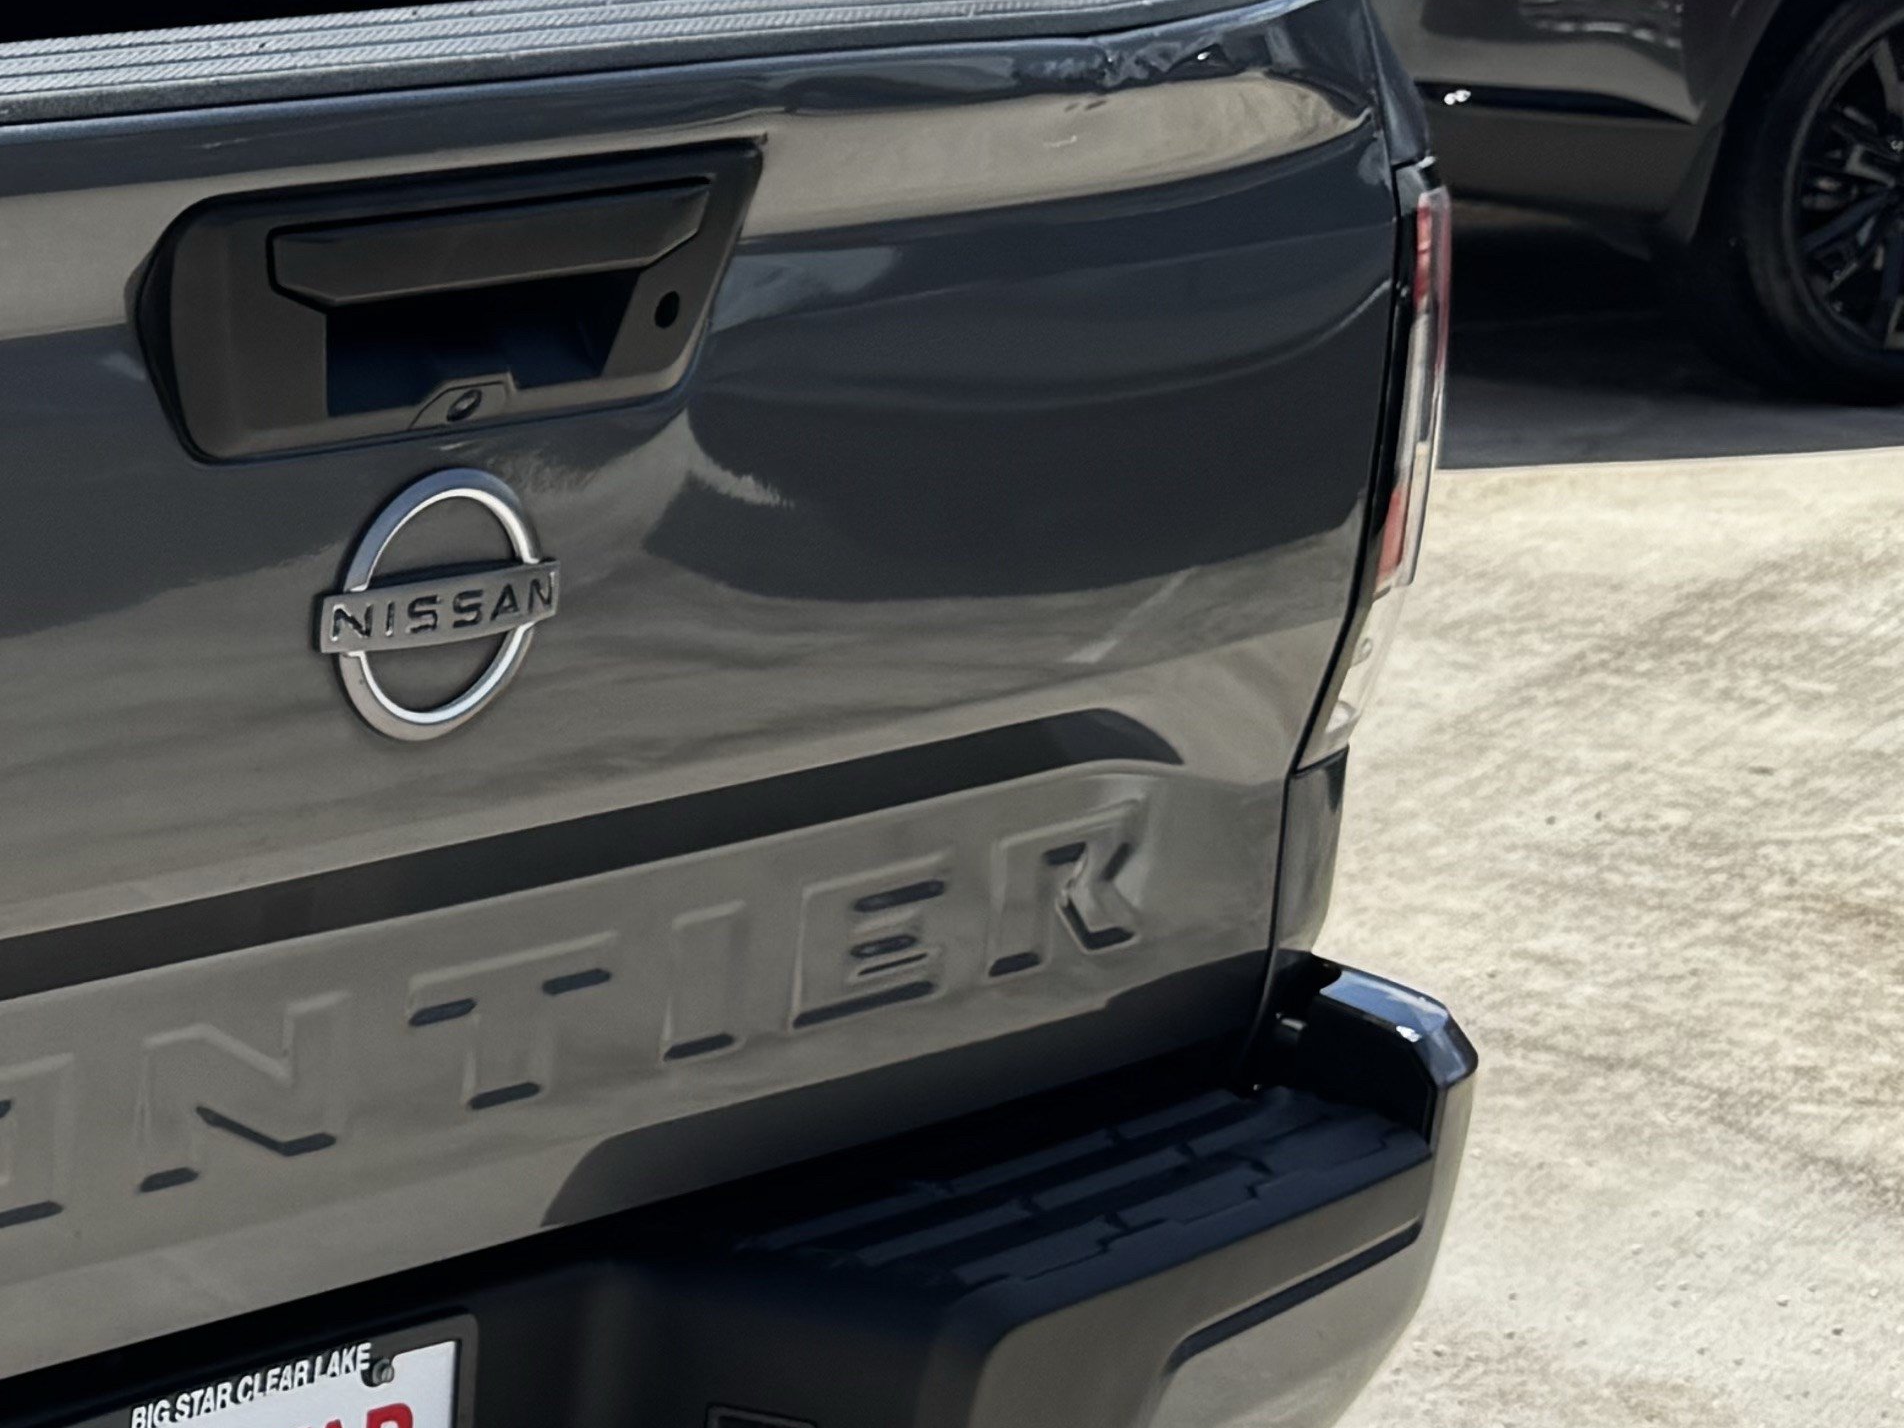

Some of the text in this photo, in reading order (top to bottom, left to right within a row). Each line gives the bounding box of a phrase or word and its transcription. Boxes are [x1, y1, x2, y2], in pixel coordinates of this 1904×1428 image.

[330, 576, 555, 642] NISSAN
[174, 1381, 233, 1423] STAR
[237, 1359, 310, 1403] CLEAR
[314, 1343, 373, 1383] LAKE
